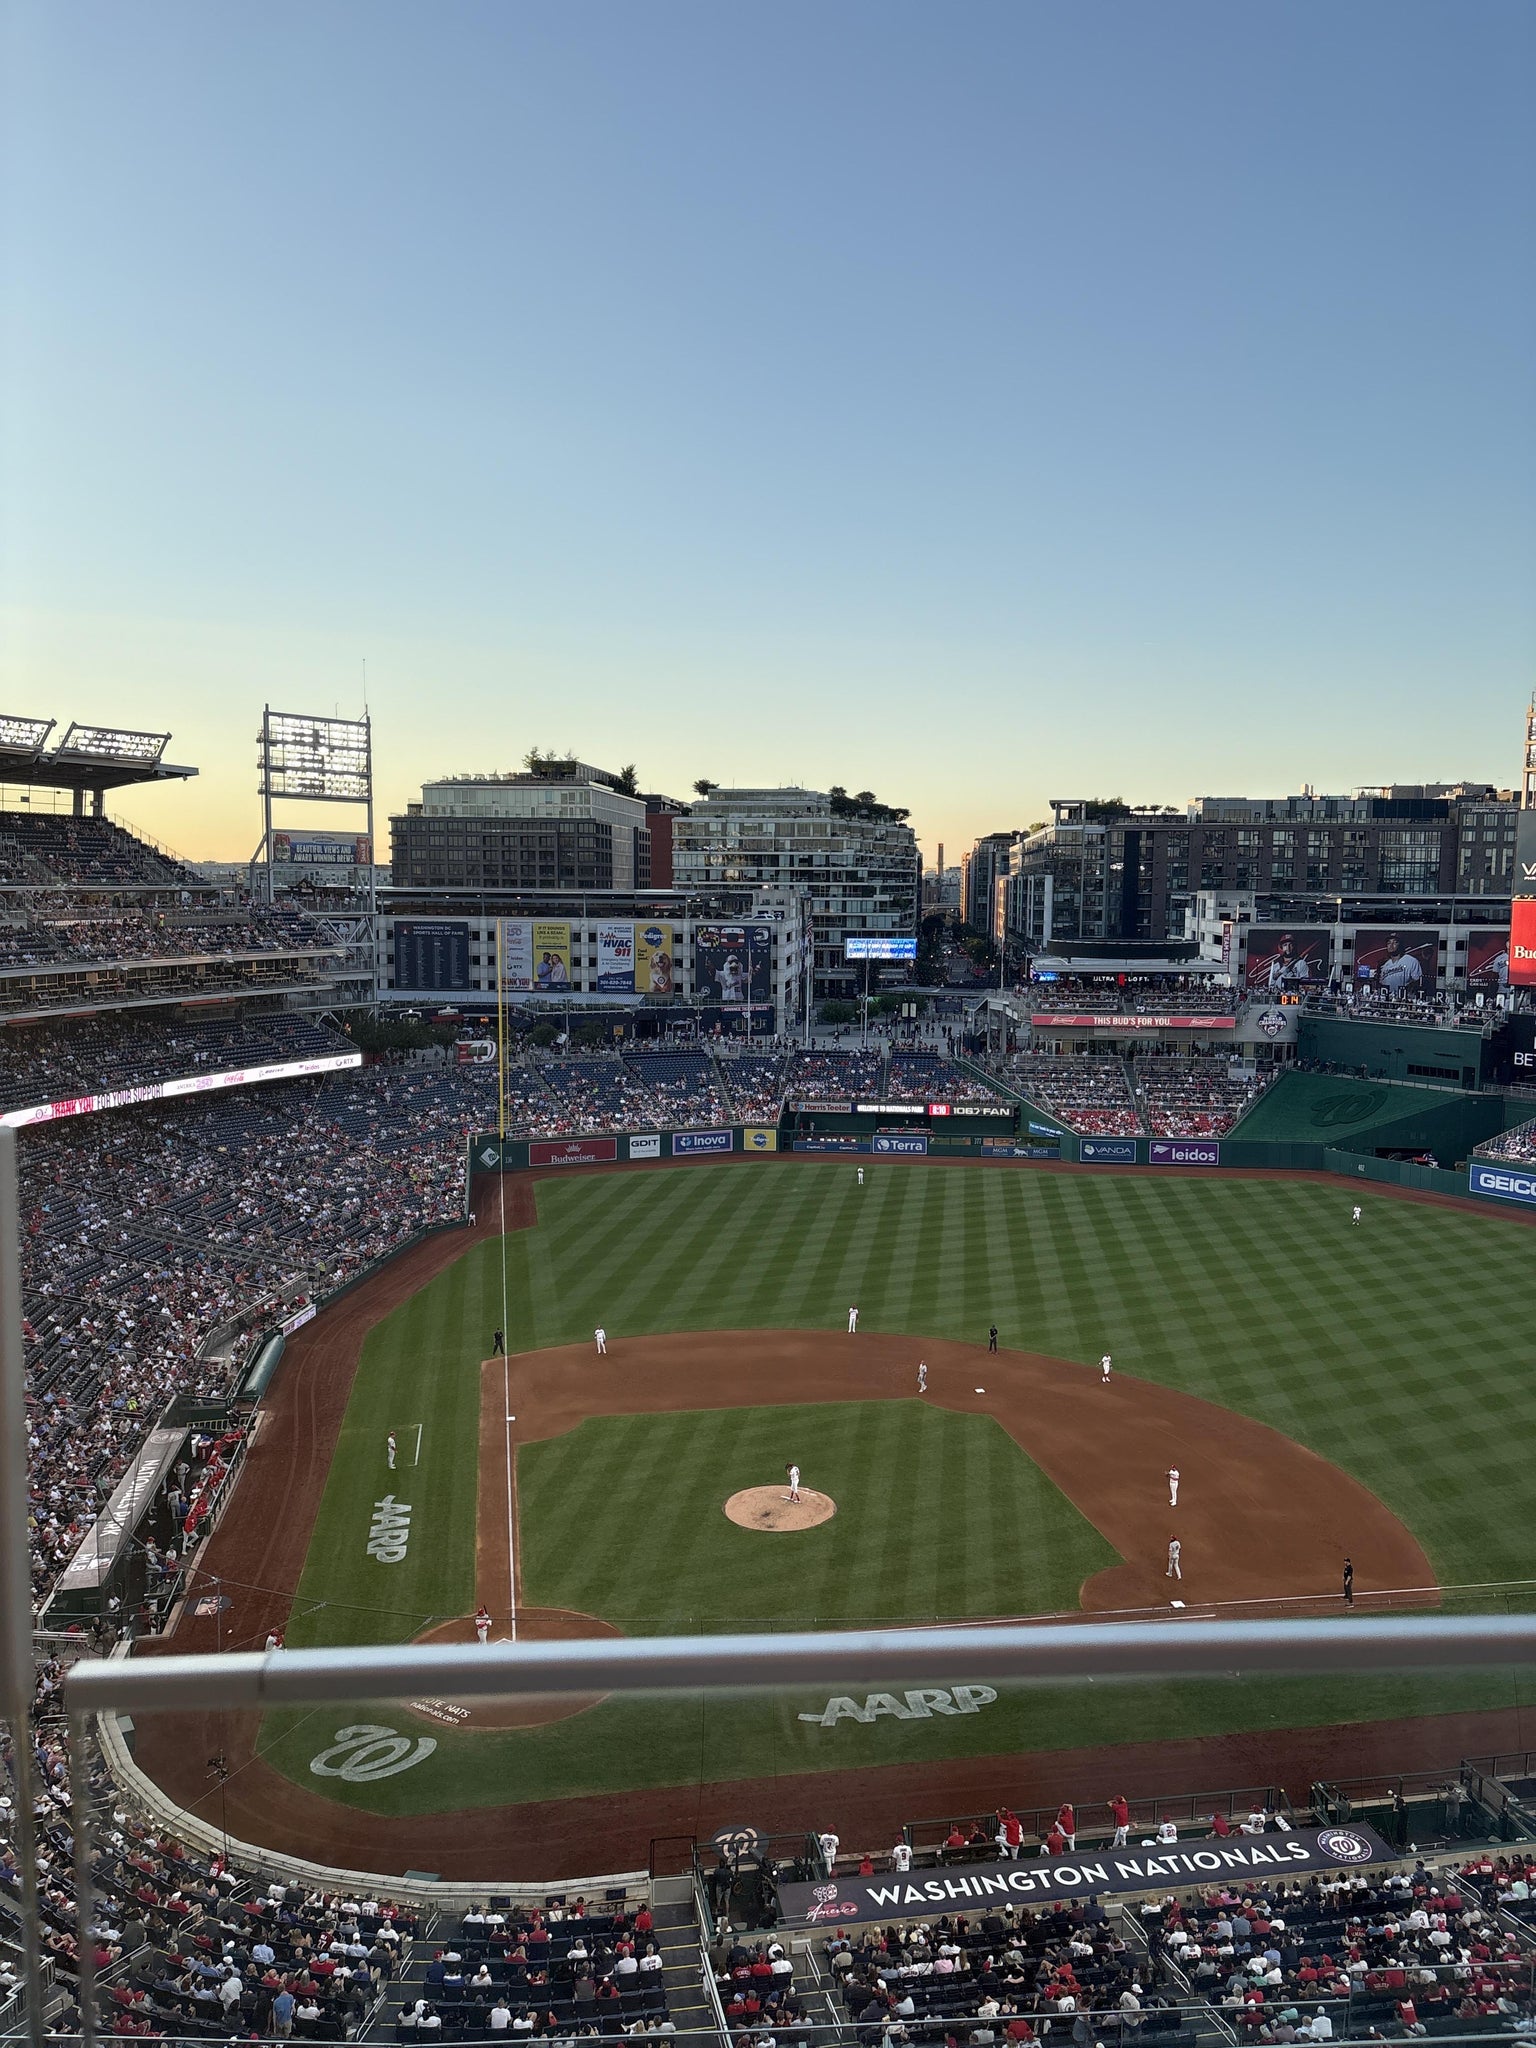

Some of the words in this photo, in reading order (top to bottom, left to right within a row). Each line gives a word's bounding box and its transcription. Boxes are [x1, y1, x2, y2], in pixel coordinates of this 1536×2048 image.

[296, 844, 323, 854] BEAUTIFUL
[324, 844, 340, 854] VIEWS
[341, 845, 352, 854] AND
[294, 853, 312, 863] AWARD
[313, 854, 336, 863] WINNING
[336, 854, 354, 863] BREWS
[639, 932, 667, 940] Pedigree
[603, 939, 632, 948] HVAC
[614, 948, 631, 957] 911
[1281, 995, 1299, 1005] 0:14
[1093, 1016, 1111, 1025] THIS
[1112, 1017, 1136, 1025] BUD'S
[1137, 1017, 1154, 1026] FOR
[1154, 1017, 1172, 1026] YOU.
[343, 1057, 354, 1065] RTX
[50, 1098, 77, 1118] THANK
[78, 1096, 95, 1114] YOU
[96, 1092, 110, 1110] FOR
[112, 1089, 131, 1107] YOUR
[133, 1083, 164, 1103] SUPPORT
[804, 1103, 827, 1111] Harris
[827, 1103, 850, 1111] Teeter
[983, 1108, 1010, 1116] FAN
[630, 1139, 658, 1147] GDIT
[693, 1135, 726, 1146] Inova
[890, 1139, 923, 1151] Terra
[1094, 1146, 1132, 1154] VANDA
[1171, 1147, 1216, 1161] leidos
[551, 1153, 596, 1163] Budweiser
[116, 1459, 161, 1510] NATIONALS
[366, 1494, 413, 1564] AARP
[70, 1553, 91, 1573] MLB
[797, 1684, 999, 1727] AARP
[409, 1701, 460, 1725] nationals.com
[444, 1704, 472, 1718] NATS
[866, 1863, 1110, 1907] WASHINGTON
[1114, 1841, 1311, 1879] NATIONALS
[805, 1902, 858, 1922] America
